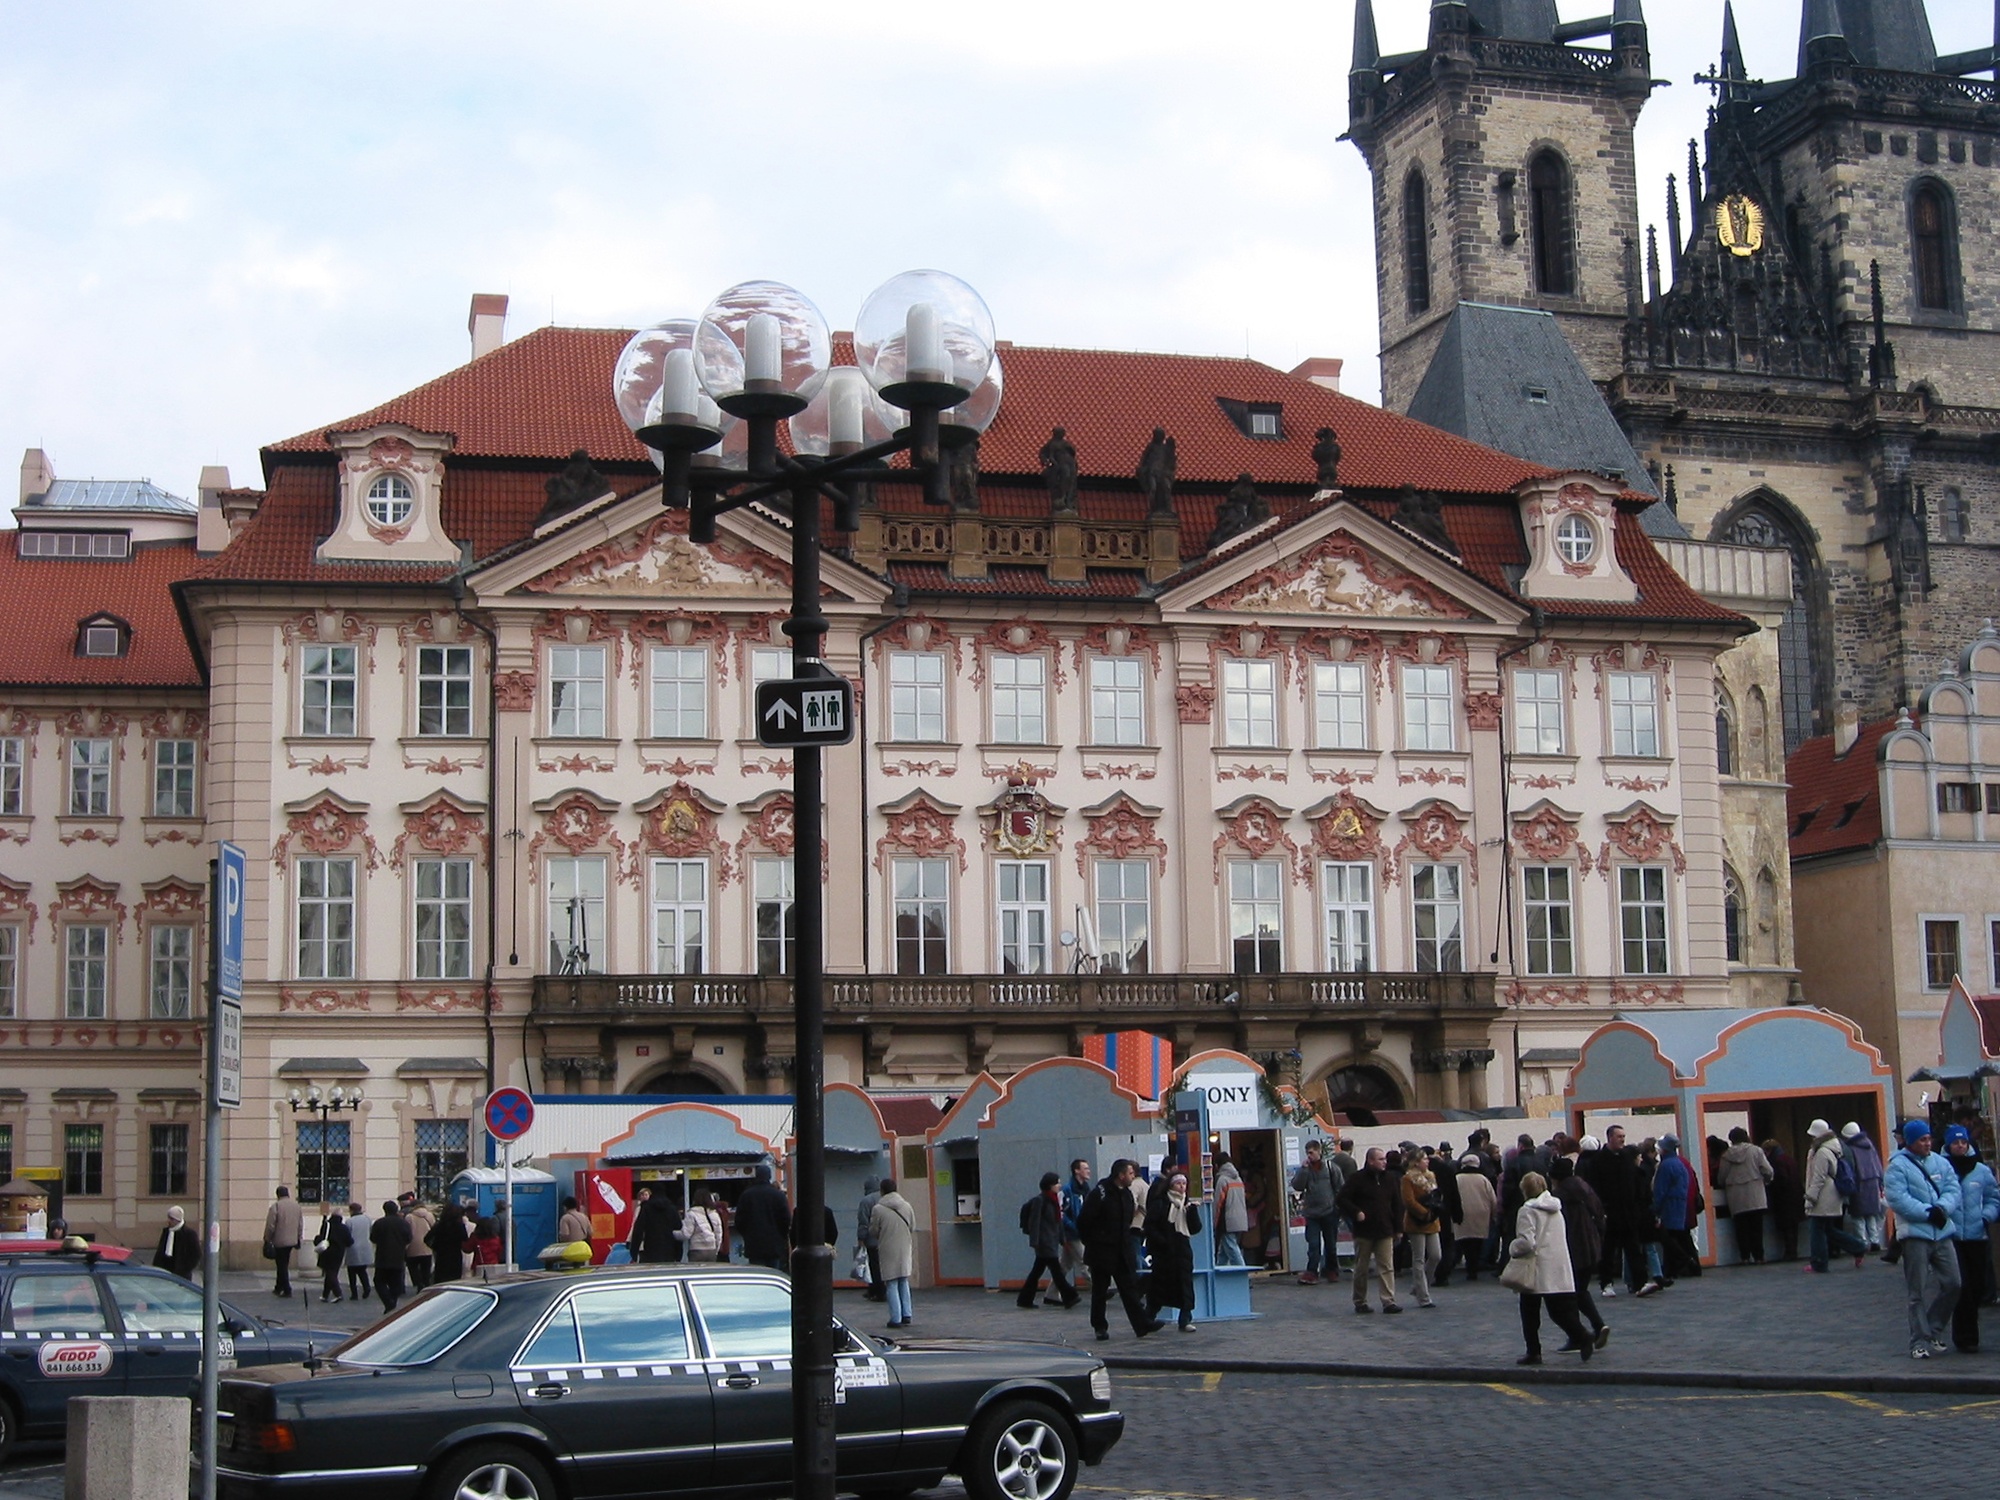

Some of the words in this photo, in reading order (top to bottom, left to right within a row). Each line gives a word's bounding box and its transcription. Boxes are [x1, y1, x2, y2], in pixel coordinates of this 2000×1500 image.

[226, 864, 240, 946] P
[1195, 1087, 1250, 1104] ONY
[218, 1342, 233, 1356] 39
[46, 1363, 62, 1372] 841
[65, 1364, 83, 1372] 666
[85, 1363, 102, 1372] 333
